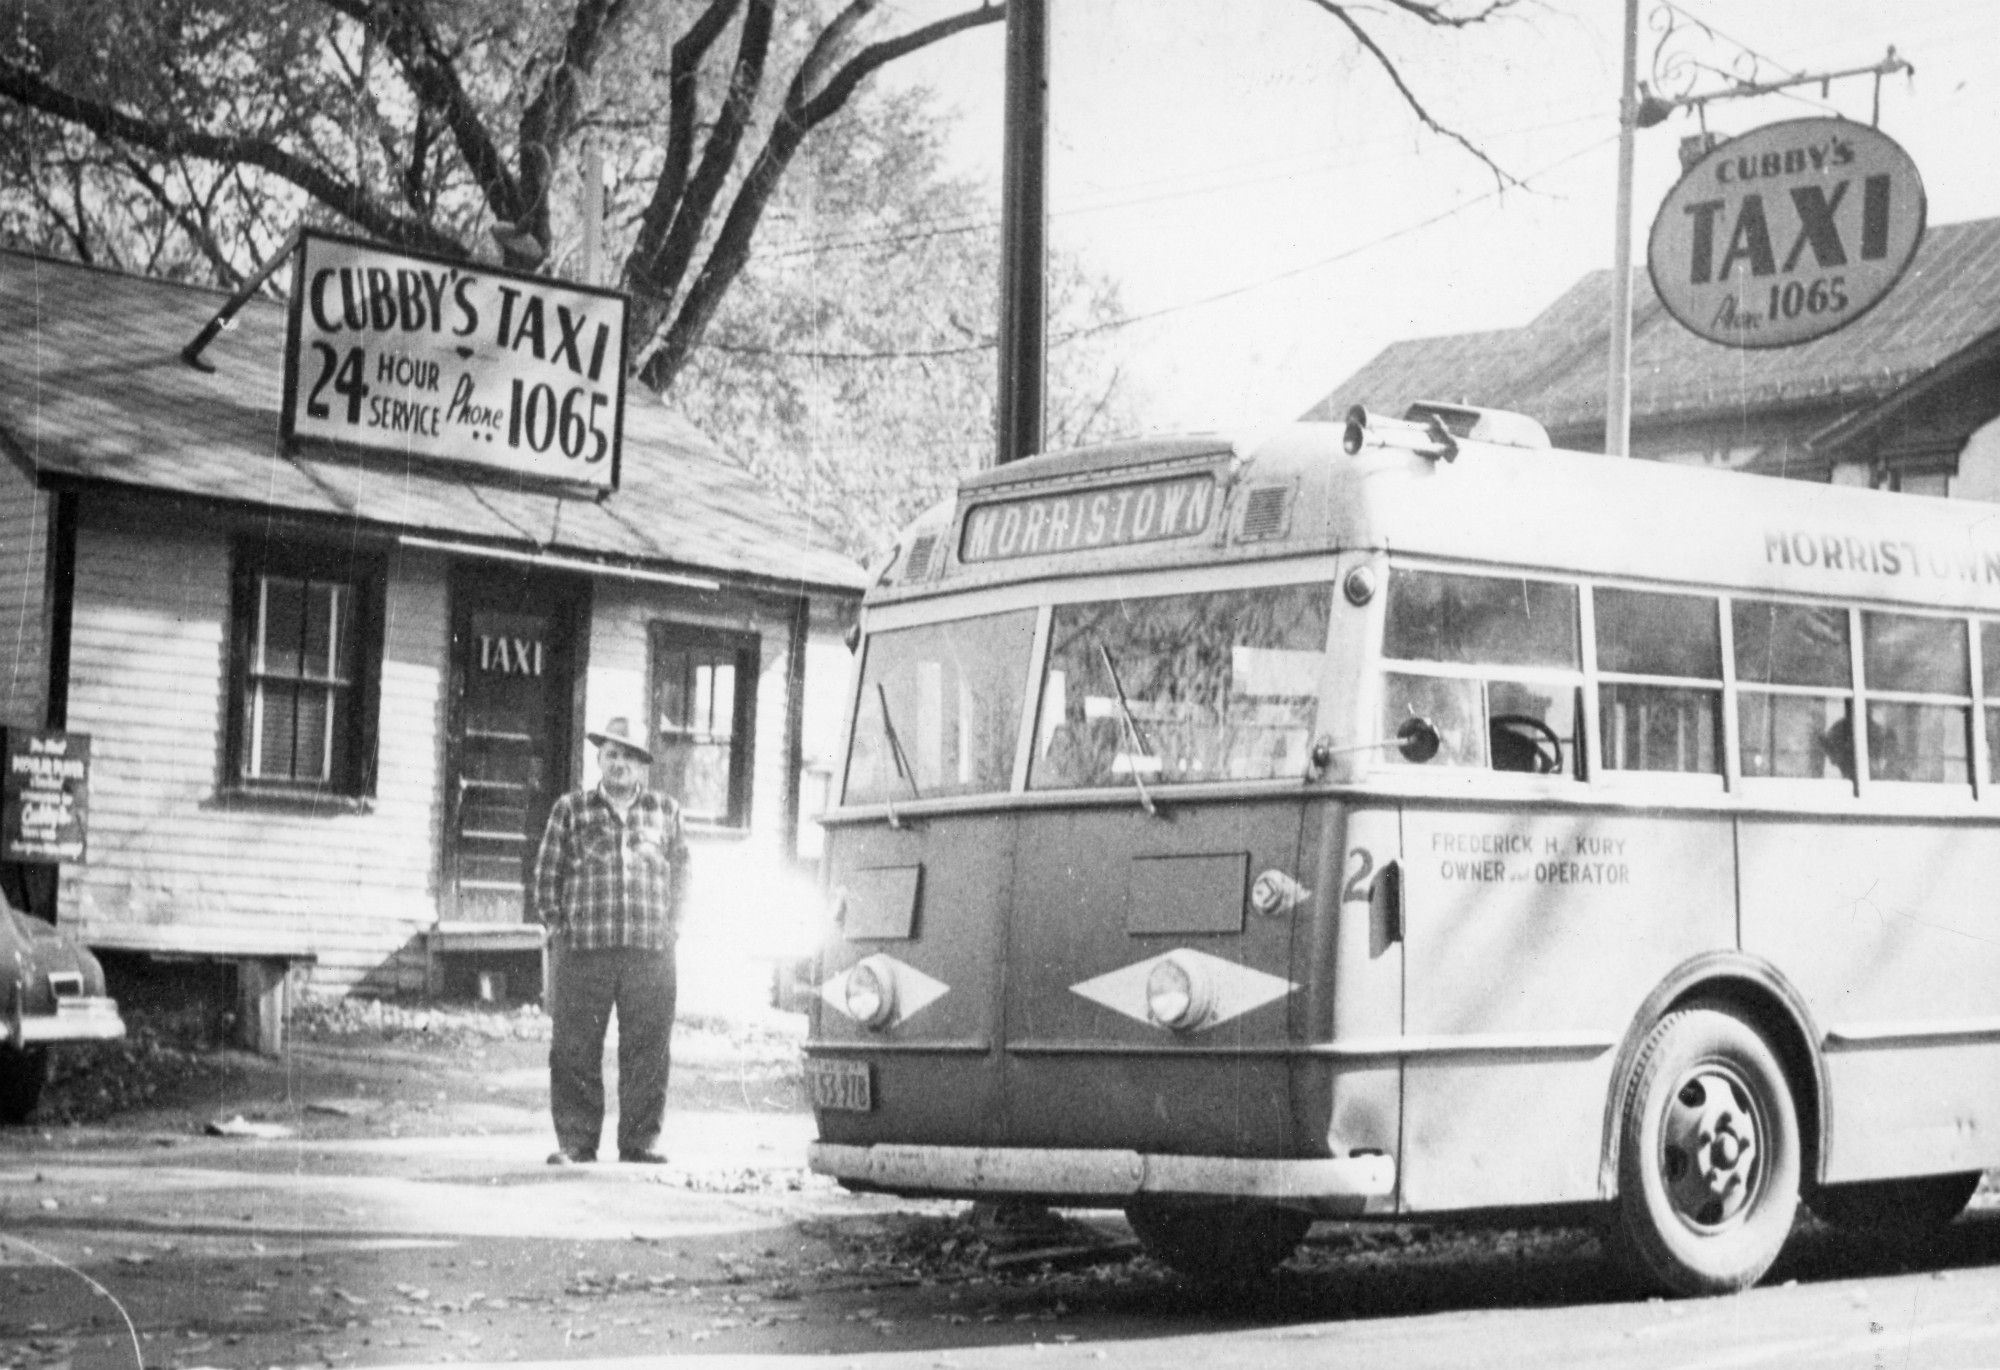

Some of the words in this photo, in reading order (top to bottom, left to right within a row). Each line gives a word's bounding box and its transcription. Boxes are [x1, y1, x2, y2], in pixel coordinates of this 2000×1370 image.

[1715, 135, 1855, 184] CUBBY'S
[1684, 173, 1891, 285] TAXI
[310, 267, 478, 337] CUBBY'S
[496, 285, 610, 381] TAXI
[1768, 276, 1849, 321] 1065
[306, 340, 369, 425] 24
[377, 353, 440, 392] HOUR
[367, 395, 441, 437] SERVICE
[446, 372, 503, 430] Phone
[508, 377, 609, 463] 1065
[969, 481, 1211, 559] MORRISTOWN
[1764, 529, 2000, 584] MORRISTOWN
[481, 634, 542, 676] TAXI
[1431, 832, 1533, 853] FREDERICK
[1575, 836, 1627, 855] KURY
[1343, 846, 1375, 904] 2
[1440, 860, 1506, 882] OWNER
[1534, 861, 1630, 885] OPERATOR
